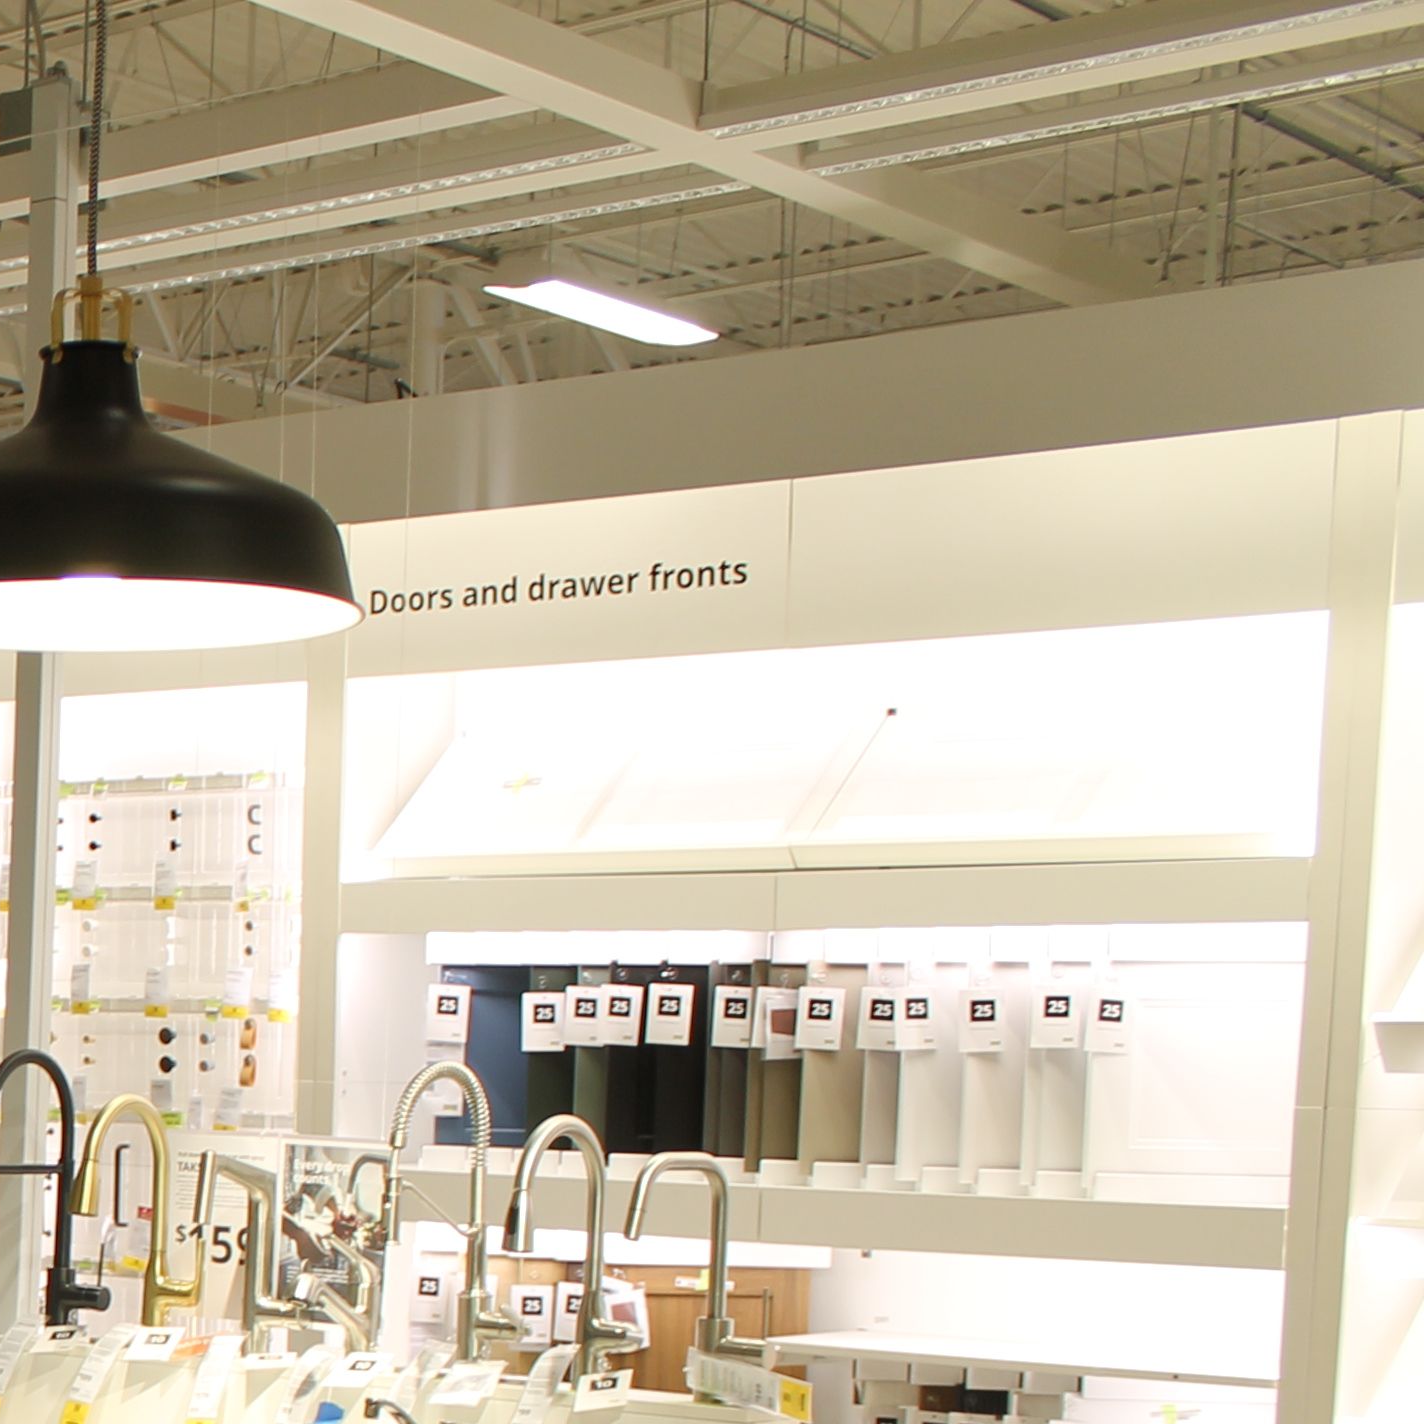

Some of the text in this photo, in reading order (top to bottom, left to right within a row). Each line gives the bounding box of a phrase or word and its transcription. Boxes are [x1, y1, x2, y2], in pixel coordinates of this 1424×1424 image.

[369, 560, 749, 616] Doors and drawer fronts
[439, 998, 457, 1012] 25
[578, 1002, 595, 1015] 25
[611, 1001, 629, 1014] 25
[661, 999, 678, 1014] 25
[727, 1002, 744, 1016] 25
[811, 1002, 830, 1016] 25
[873, 1003, 892, 1016] 25
[907, 1003, 926, 1016] 25
[973, 1004, 993, 1018] 25
[1047, 1000, 1067, 1015] 25
[1102, 1004, 1122, 1018] 25
[536, 1007, 554, 1021] 25
[421, 1280, 437, 1293] 25
[524, 1300, 540, 1312] 25
[595, 1379, 613, 1389] 10
